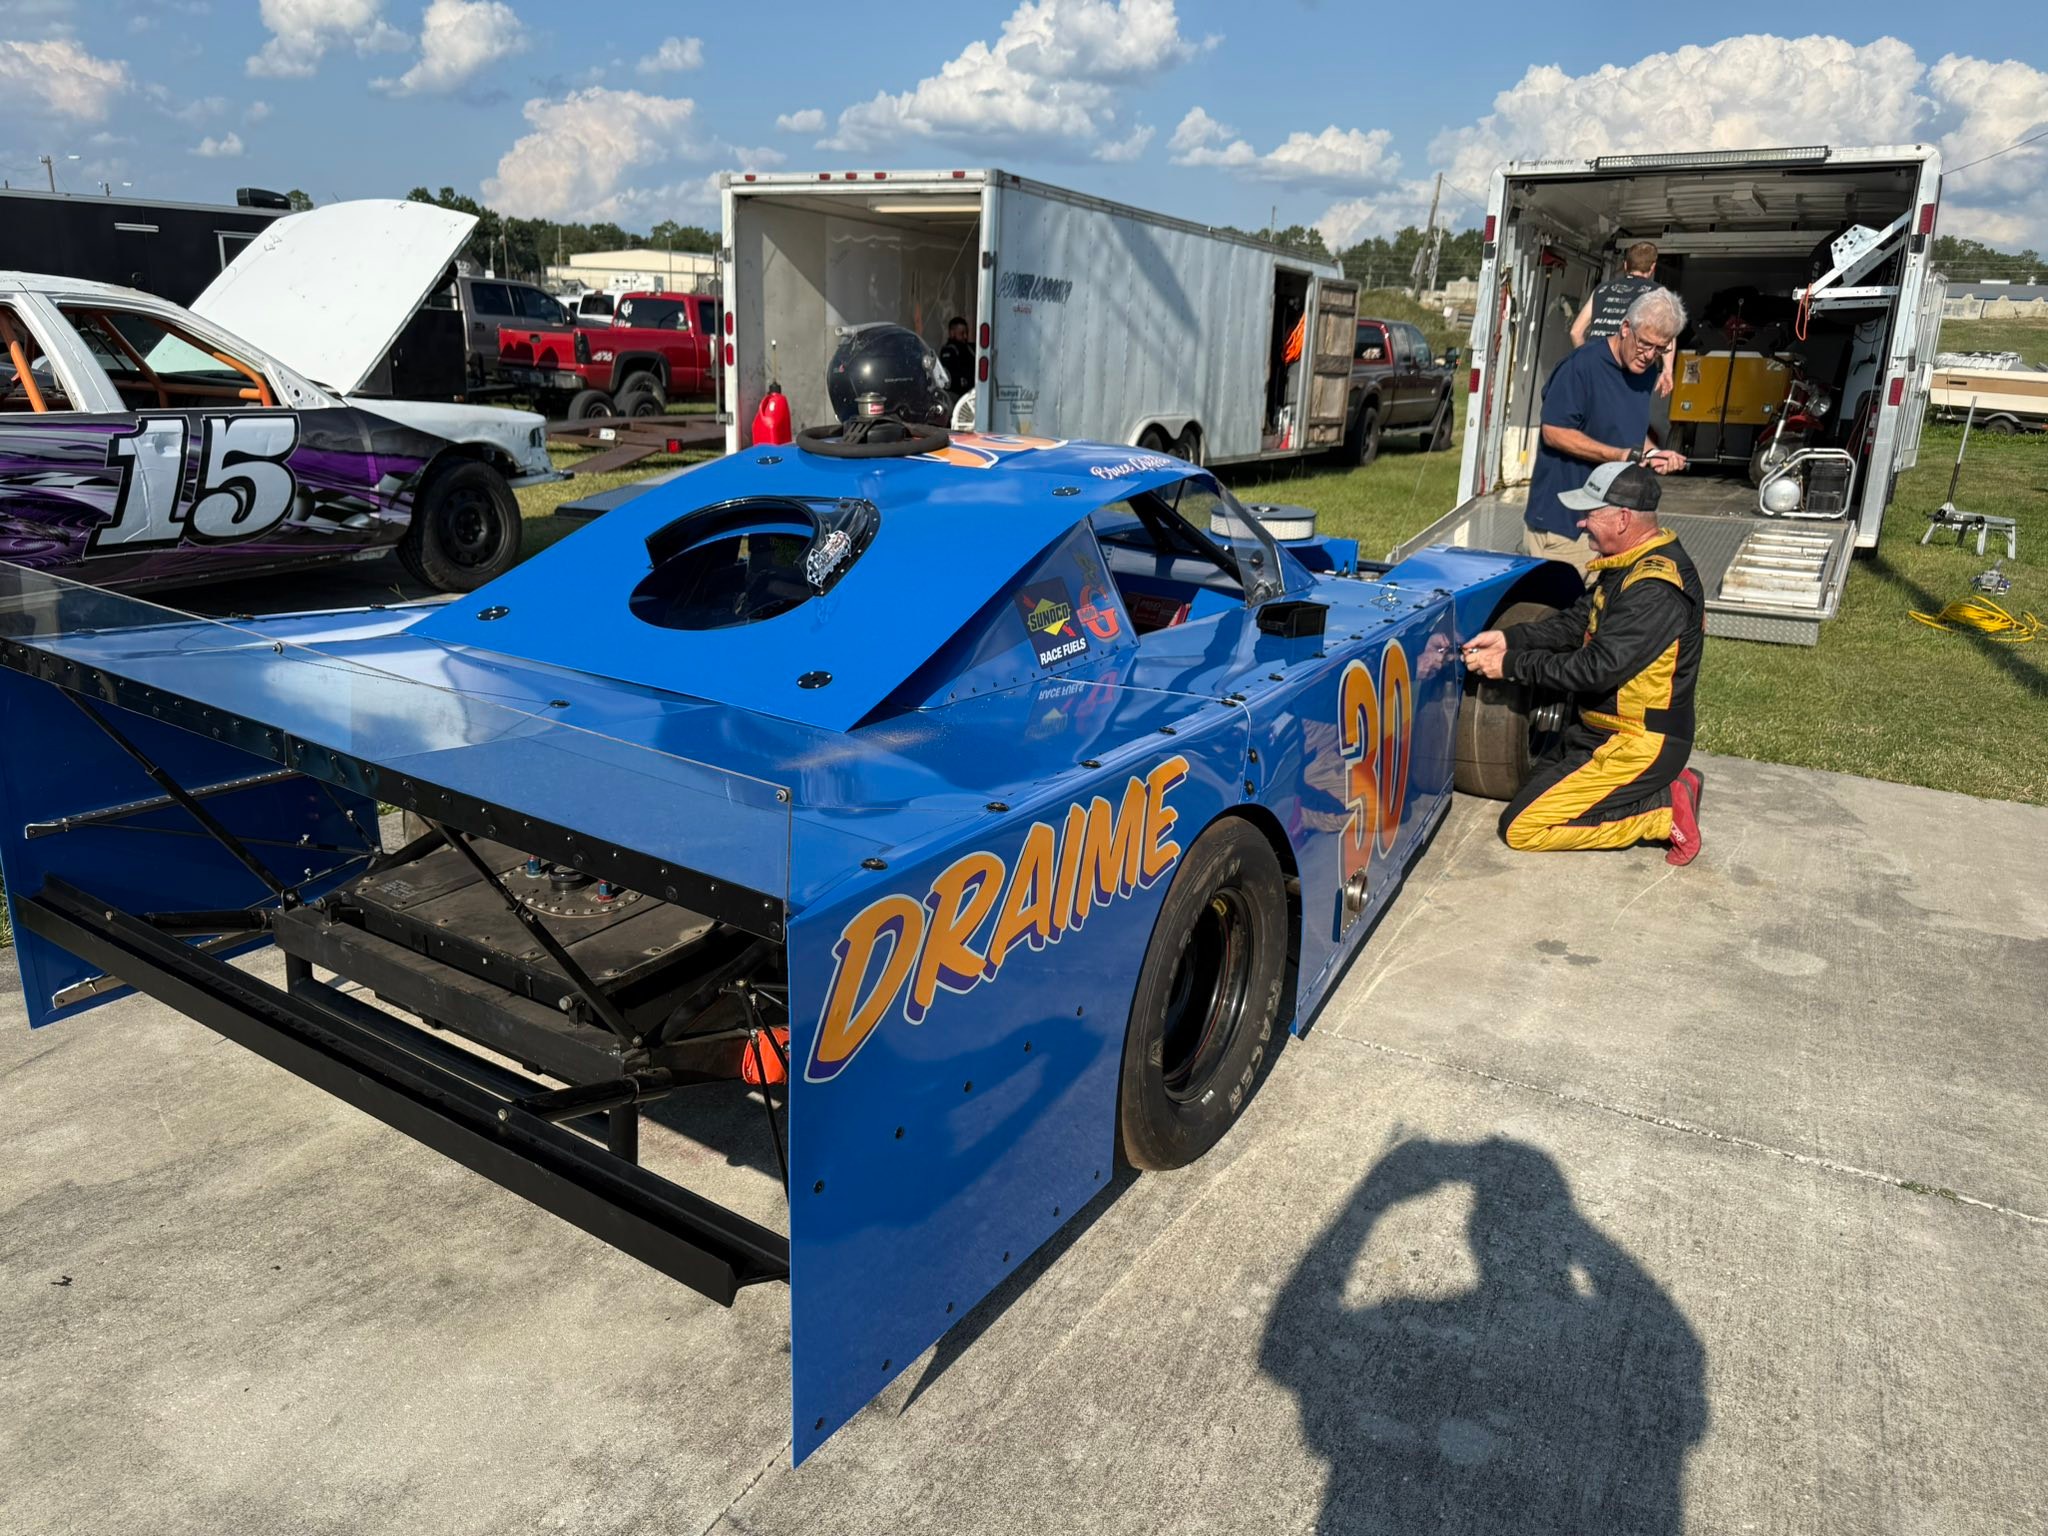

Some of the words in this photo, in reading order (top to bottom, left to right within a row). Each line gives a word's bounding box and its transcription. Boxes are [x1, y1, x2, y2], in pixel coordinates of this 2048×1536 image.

[83, 414, 301, 558] 15
[1029, 603, 1070, 631] SUNOCO
[1039, 645, 1063, 666] RACE
[1063, 637, 1087, 657] FUELS
[1338, 638, 1412, 889] 30
[804, 755, 1190, 1083] DRAIME
